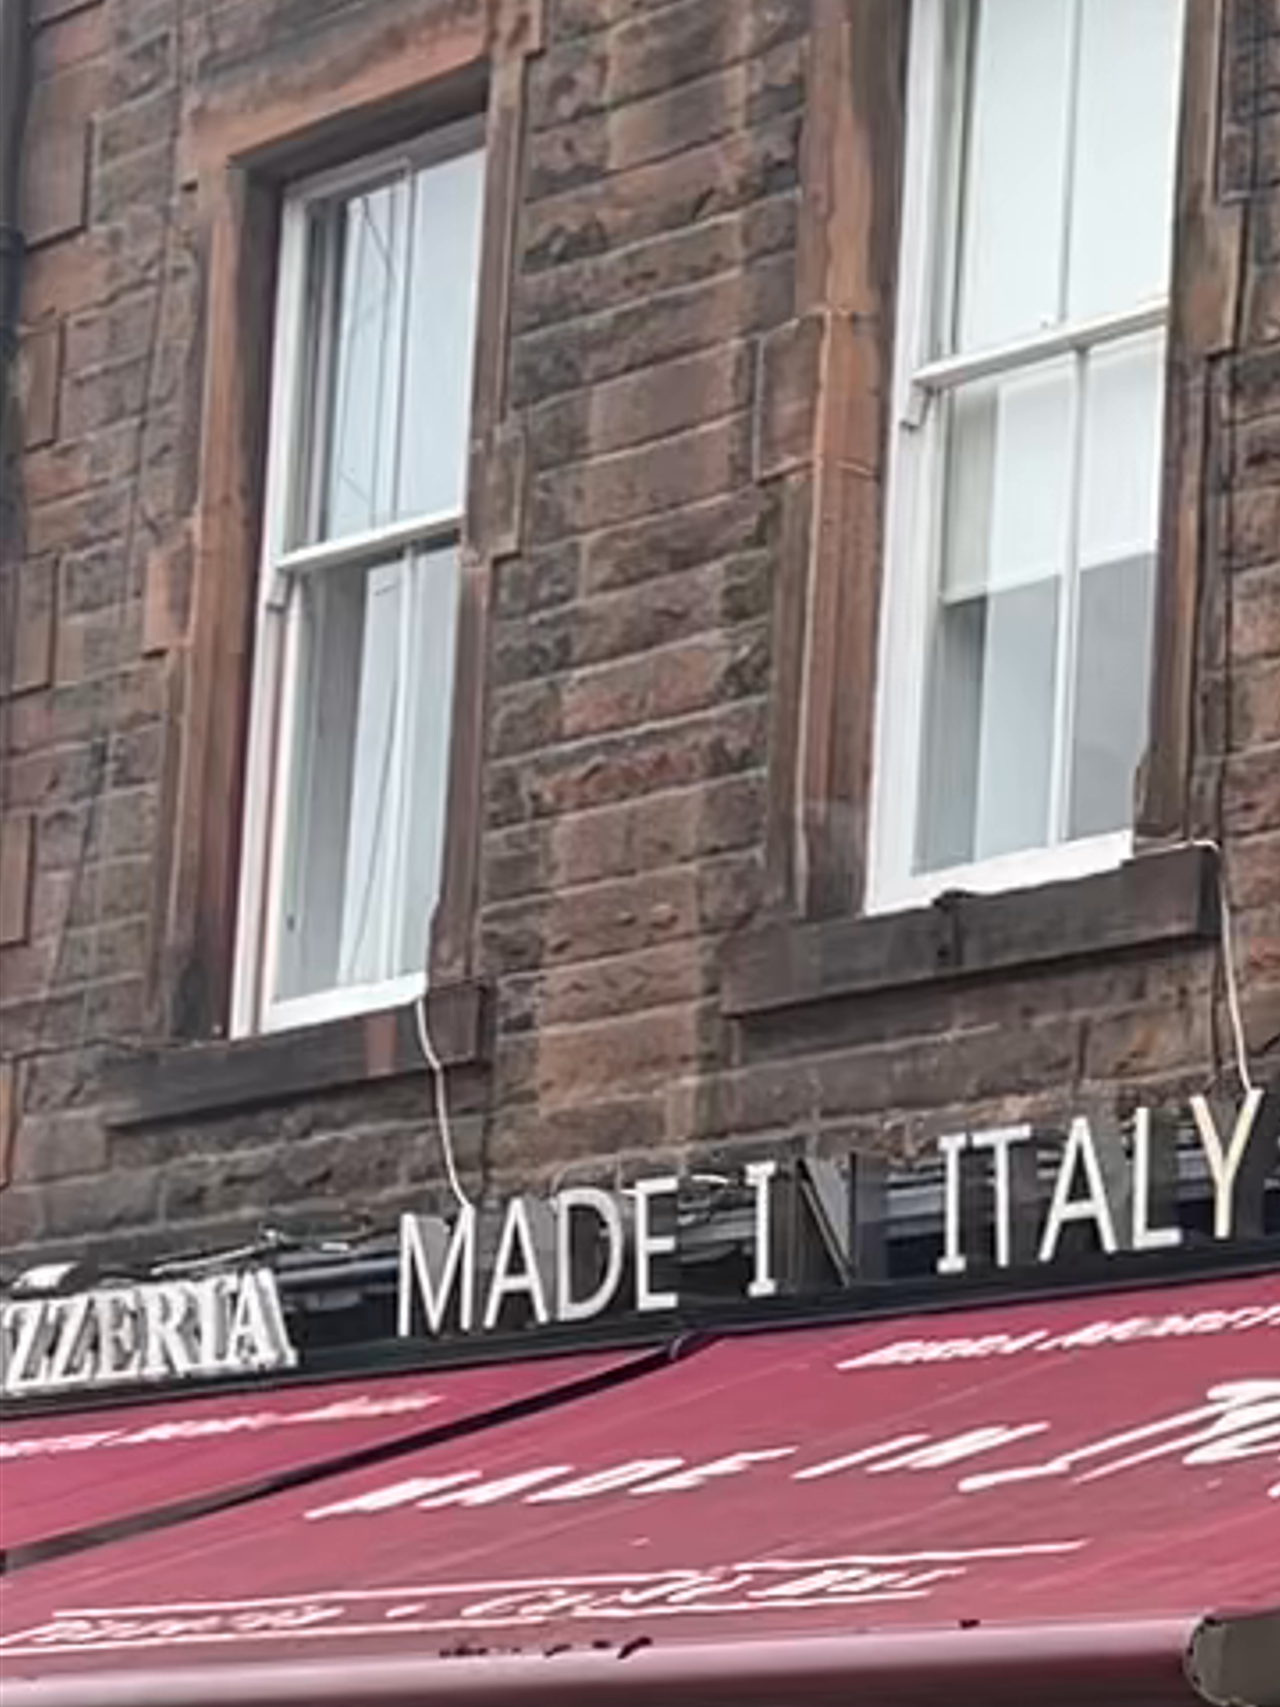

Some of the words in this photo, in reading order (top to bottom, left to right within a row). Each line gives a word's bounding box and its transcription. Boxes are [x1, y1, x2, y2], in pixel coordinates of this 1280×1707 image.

[0, 1267, 298, 1394] ZZERIA
[398, 1176, 680, 1338] MADE
[744, 1157, 880, 1298] IN
[936, 1089, 1264, 1274] ITALY
